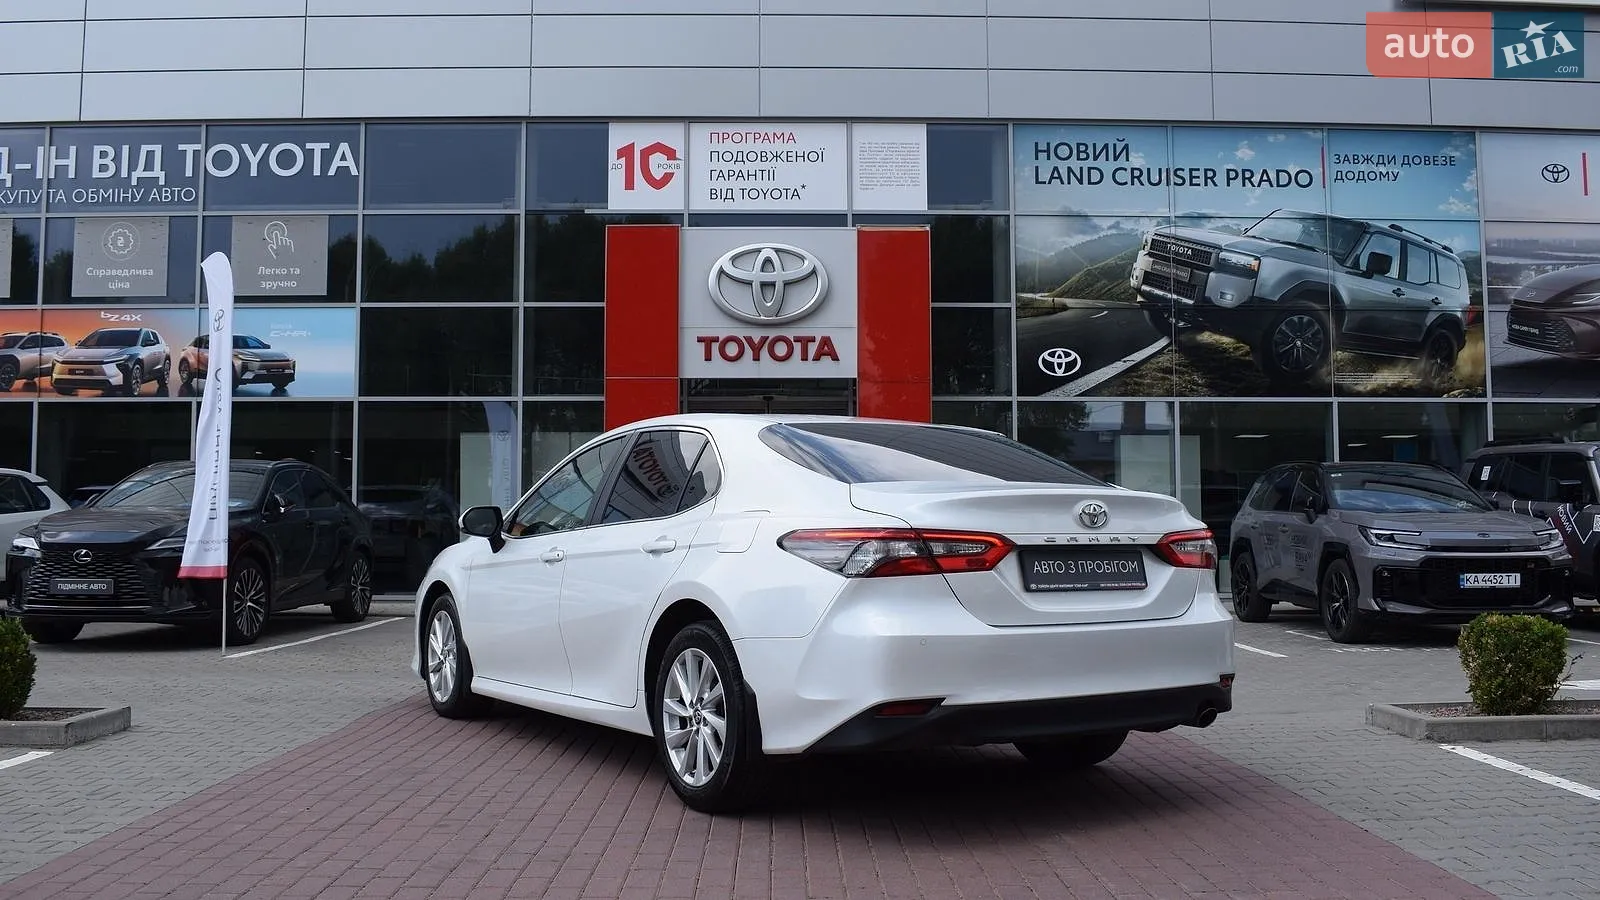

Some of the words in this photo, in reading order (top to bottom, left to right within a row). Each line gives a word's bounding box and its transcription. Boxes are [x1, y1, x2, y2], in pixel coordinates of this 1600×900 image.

[709, 132, 796, 144] ПРОГРАМА
[709, 147, 826, 165] ПОДОВЖЕНОЇ
[1034, 138, 1131, 162] НОВИЙ
[92, 145, 166, 186] ВІД
[178, 142, 359, 178] TOYOTA
[1334, 152, 1397, 168] ЗАВЖДИ
[1400, 153, 1457, 168] ДОВЕЗЕ
[709, 166, 777, 181] ГАРАНТІЇ
[1034, 166, 1104, 186] LAND
[1111, 167, 1218, 188] CRUISER
[1226, 168, 1314, 189] PRADO
[1334, 169, 1401, 185] ДОДОМУ
[48, 189, 66, 203] ТА
[72, 187, 144, 204] ОБМІНУ
[148, 187, 196, 202] АВТО
[709, 187, 735, 202] ВІД
[1167, 243, 1192, 256] TOYOTA
[86, 266, 154, 278] Справедлива
[257, 265, 288, 276] Легко
[289, 267, 301, 276] та
[108, 280, 131, 290] ціна
[259, 280, 298, 290] зручно
[696, 335, 840, 362] TOYOTA
[1033, 560, 1065, 575] АВТО
[1078, 559, 1139, 574] ПРОБІГОМ
[57, 583, 89, 591] ПІДМІННЕ
[1465, 574, 1480, 586] KA
[1481, 574, 1504, 586] 4452
